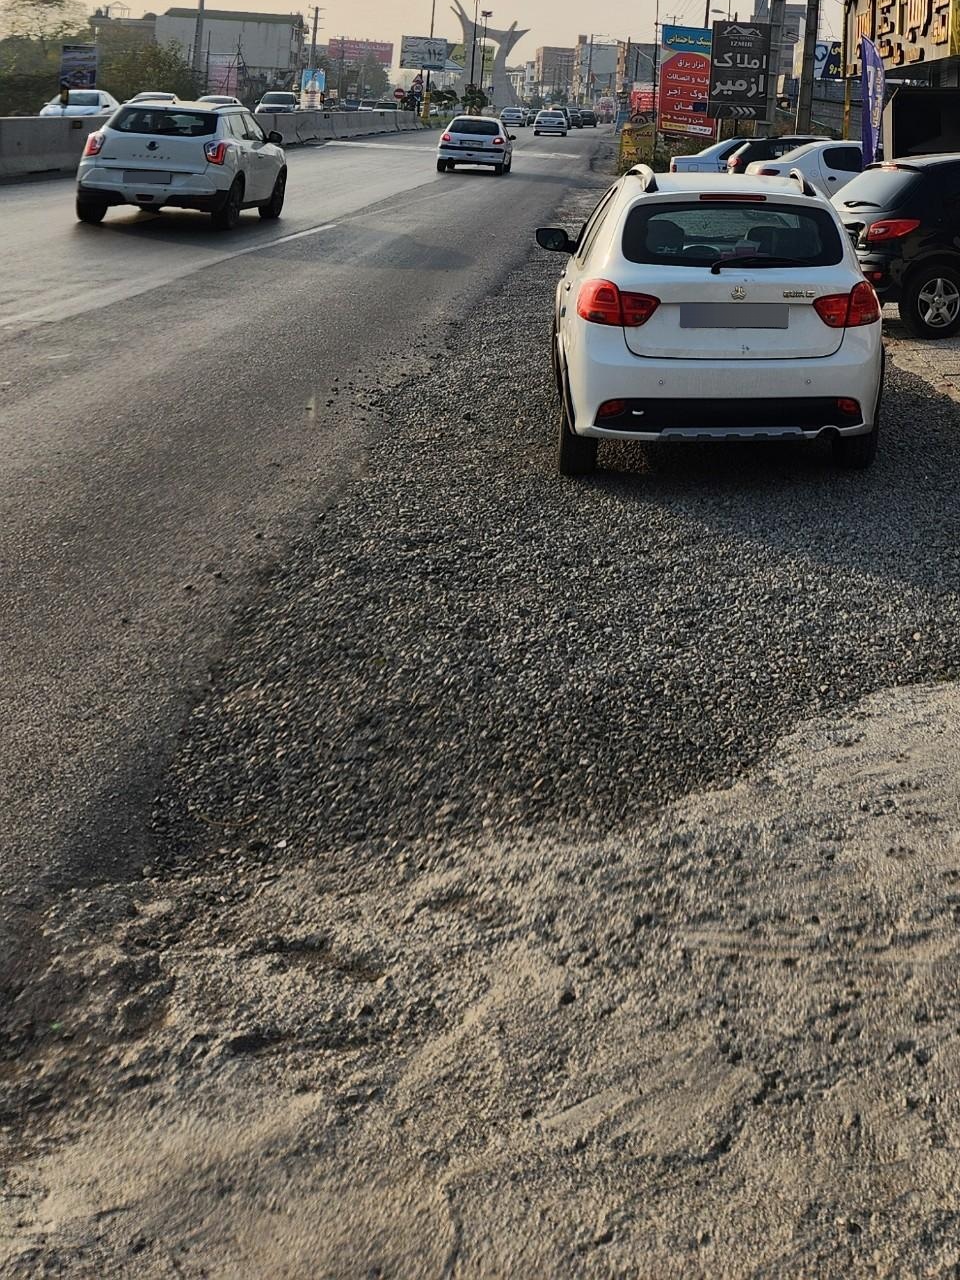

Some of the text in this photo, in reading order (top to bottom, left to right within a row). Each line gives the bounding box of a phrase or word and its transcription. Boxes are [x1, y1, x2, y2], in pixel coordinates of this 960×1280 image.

[713, 52, 767, 69] املاک
[697, 76, 710, 84] وله
[689, 89, 709, 100] لوک
